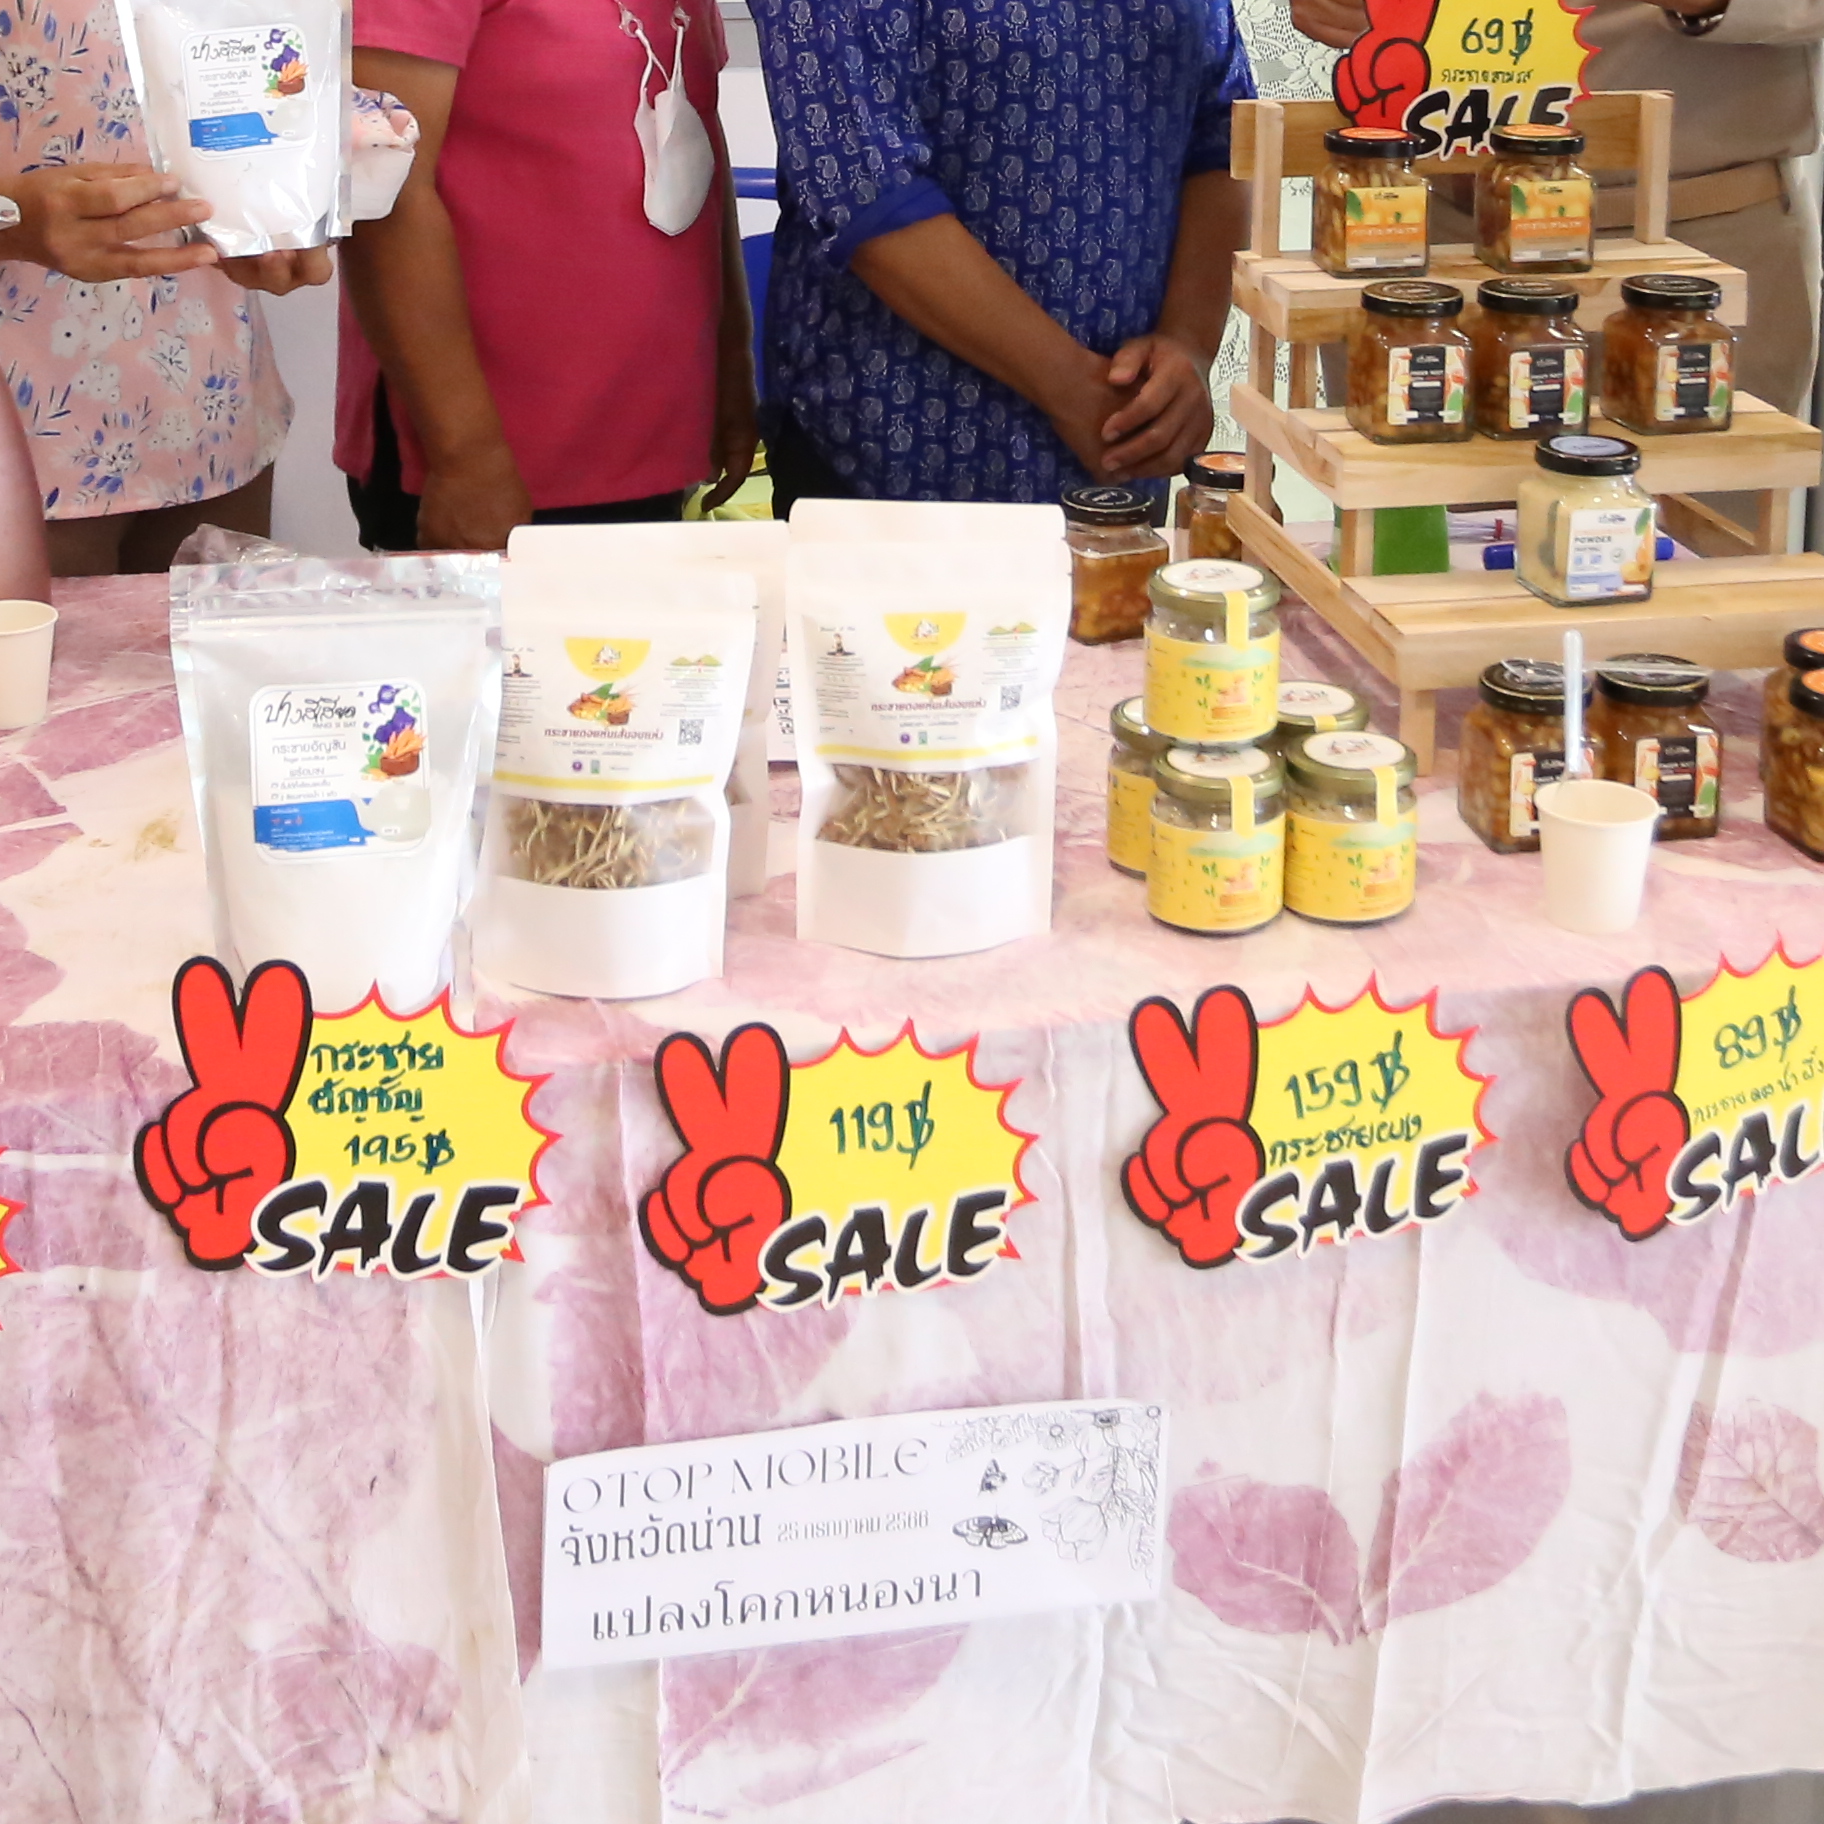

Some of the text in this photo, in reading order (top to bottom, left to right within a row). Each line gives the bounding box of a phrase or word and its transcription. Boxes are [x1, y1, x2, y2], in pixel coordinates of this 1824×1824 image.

[256, 1179, 520, 1275] SALE
[1240, 1133, 1469, 1259] SALE
[764, 1189, 1007, 1306] SALE
[562, 1437, 929, 1514] OTOP MOBILE
[560, 1506, 763, 1569] จังหวัดน่าน
[777, 1521, 799, 1543] 25
[885, 1509, 929, 1532] 2566
[590, 1566, 985, 1643] แปลงโคกหนองนา
